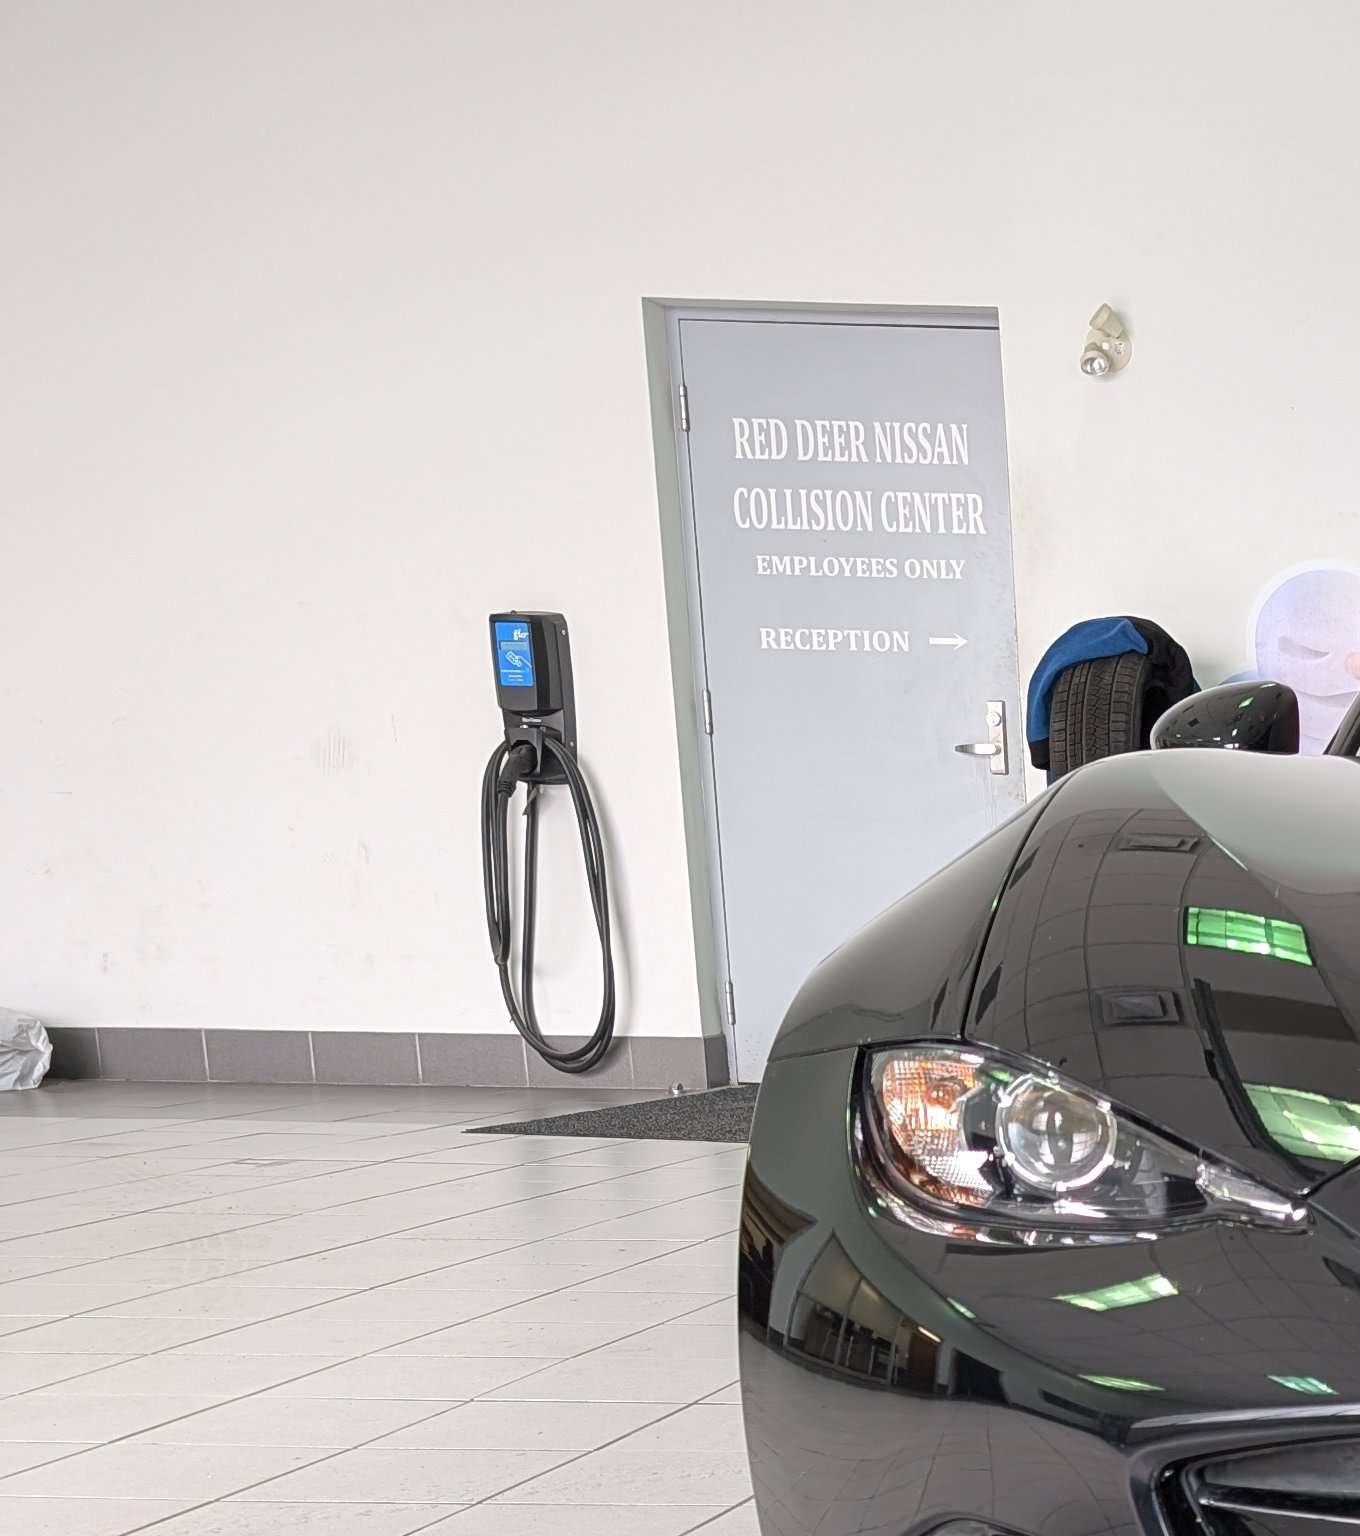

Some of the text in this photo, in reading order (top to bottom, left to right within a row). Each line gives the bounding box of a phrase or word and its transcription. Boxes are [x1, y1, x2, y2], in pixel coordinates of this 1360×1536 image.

[732, 417, 969, 465] RED DEER NISSAN
[733, 487, 986, 535] COLLISION CENTER
[756, 554, 965, 580] EMPLOYEES ONLY
[759, 627, 910, 652] RECEPTION
